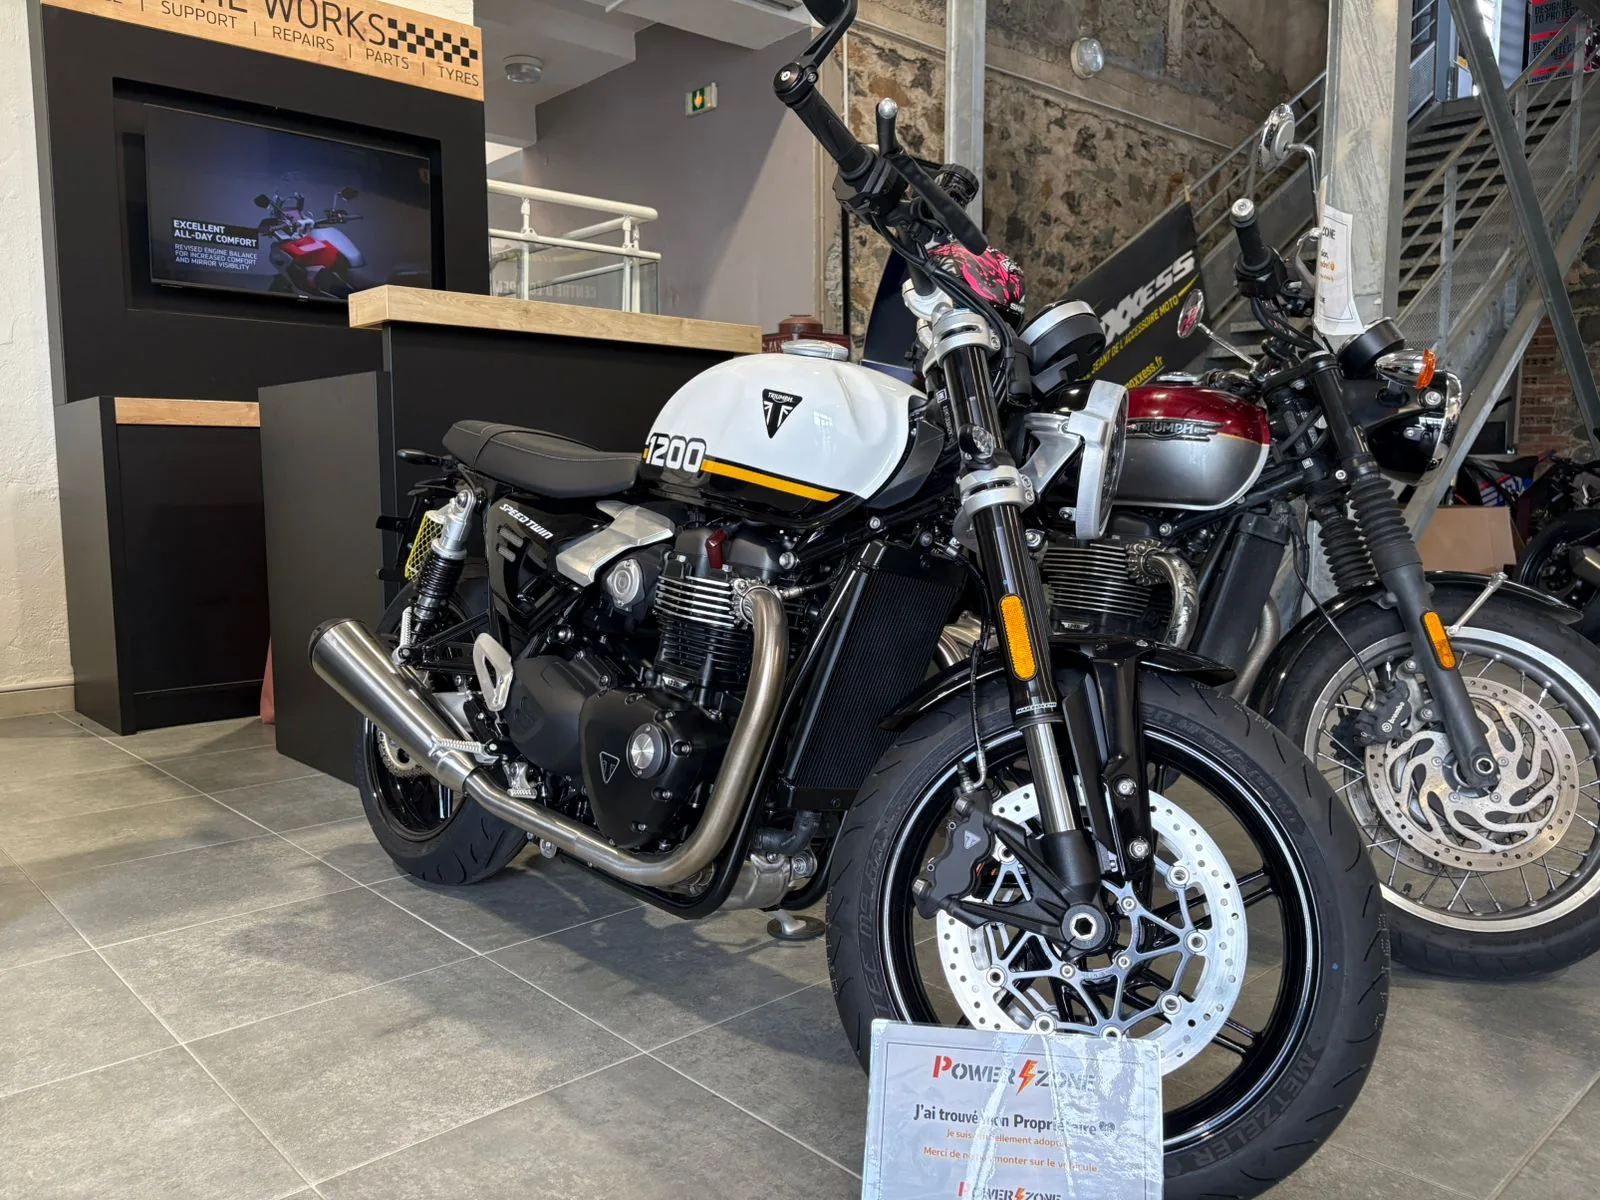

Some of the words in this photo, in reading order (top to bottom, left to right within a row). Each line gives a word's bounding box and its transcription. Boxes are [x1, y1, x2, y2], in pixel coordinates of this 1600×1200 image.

[266, 0, 388, 47] WORKS
[161, 1, 237, 29] SUPPORT
[272, 26, 335, 53] REPAIRS
[365, 48, 410, 70] PARTS
[437, 65, 480, 87] TYRES
[173, 219, 226, 234] EXCELLENT
[174, 229, 213, 242] ALL-DAY
[215, 235, 257, 247] COMFORT
[174, 243, 203, 253] REVISED
[204, 247, 228, 256] ENGINE
[229, 250, 258, 260] BALANCE
[190, 251, 226, 262] INCREASED
[227, 256, 256, 265] COMFORT
[175, 256, 190, 264] AND
[191, 258, 217, 267] MIRROR
[218, 262, 250, 271] VISIBILITY
[1100, 250, 1195, 347] XXESS
[1159, 294, 1180, 317] MOTO
[767, 391, 794, 404] TRIUMPH
[1136, 422, 1195, 436] TRIUMPH
[645, 434, 706, 474] 1200
[498, 503, 530, 523] SPEED
[525, 519, 554, 540] TWIN
[1195, 1049, 1319, 1165] METZELER
[913, 1103, 936, 1121] J'ai
[939, 1108, 979, 1124] trouvé
[1013, 1114, 1097, 1136] Propriéaire
[956, 1130, 972, 1140] suis
[923, 1146, 948, 1157] Merci
[949, 1149, 961, 1158] de
[995, 1155, 1027, 1166] monter
[1029, 1158, 1045, 1167] sur
[1047, 1158, 1056, 1168] le
